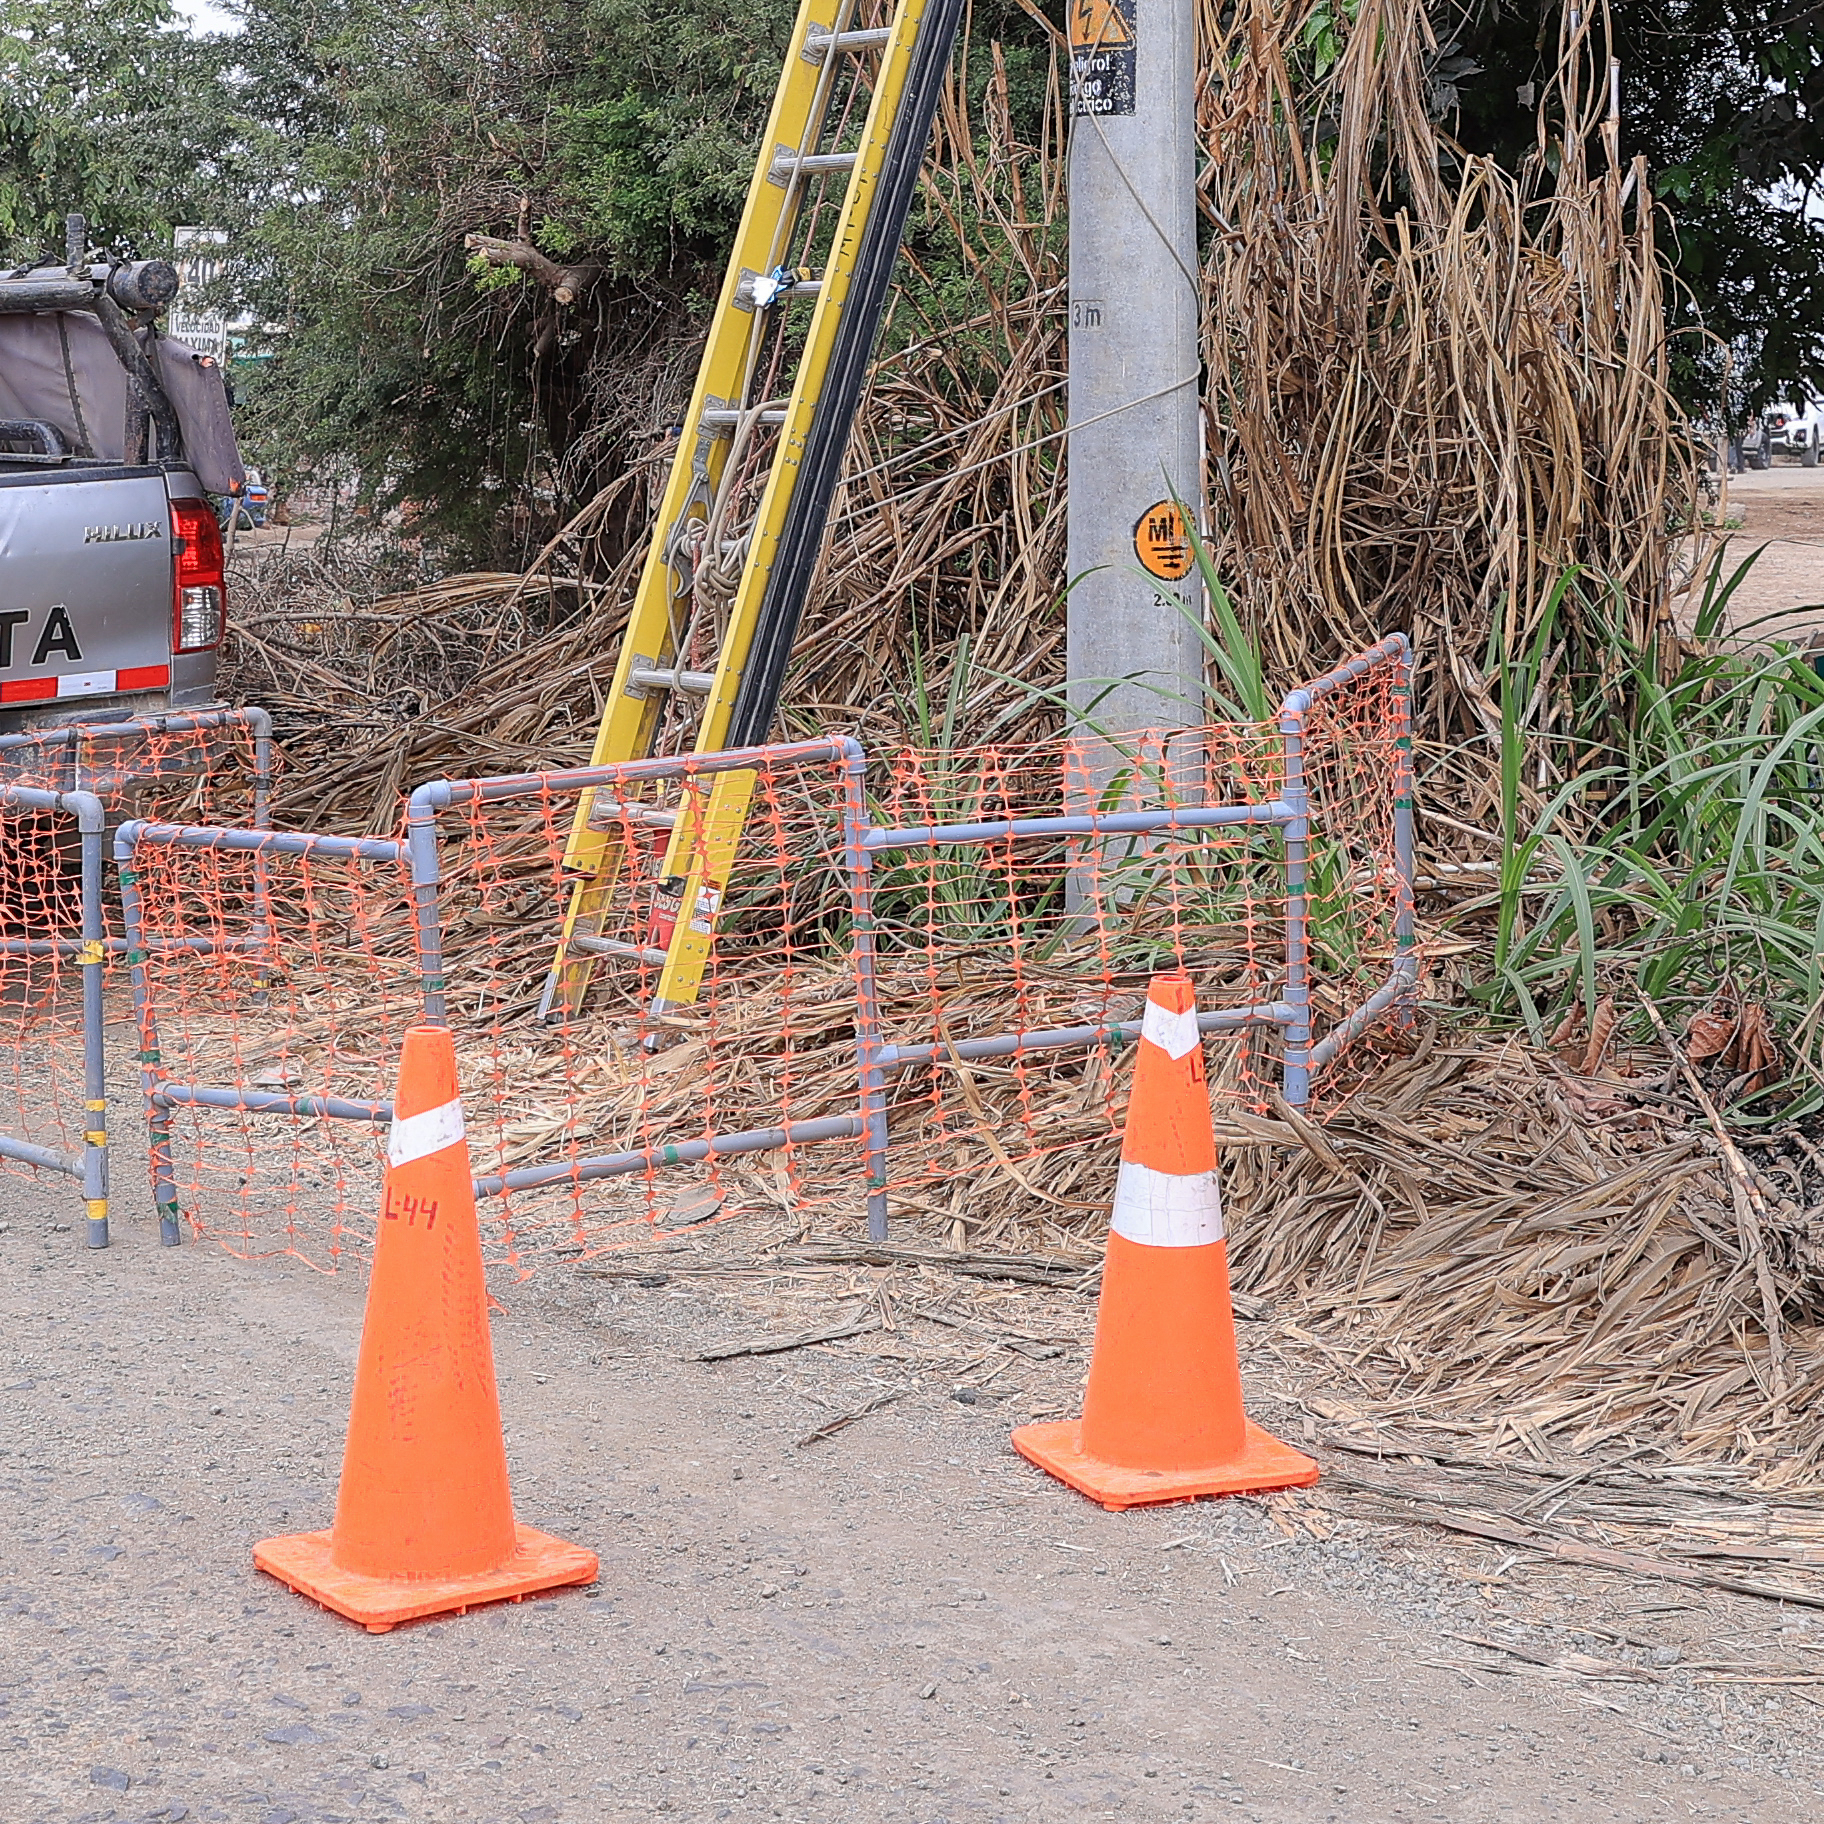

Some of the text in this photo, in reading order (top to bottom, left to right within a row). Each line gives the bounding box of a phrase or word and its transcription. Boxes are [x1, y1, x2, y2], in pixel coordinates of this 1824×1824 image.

[176, 321, 220, 334] VELOCIDAD
[177, 335, 219, 354] AXIMA
[83, 521, 162, 544] HILUX
